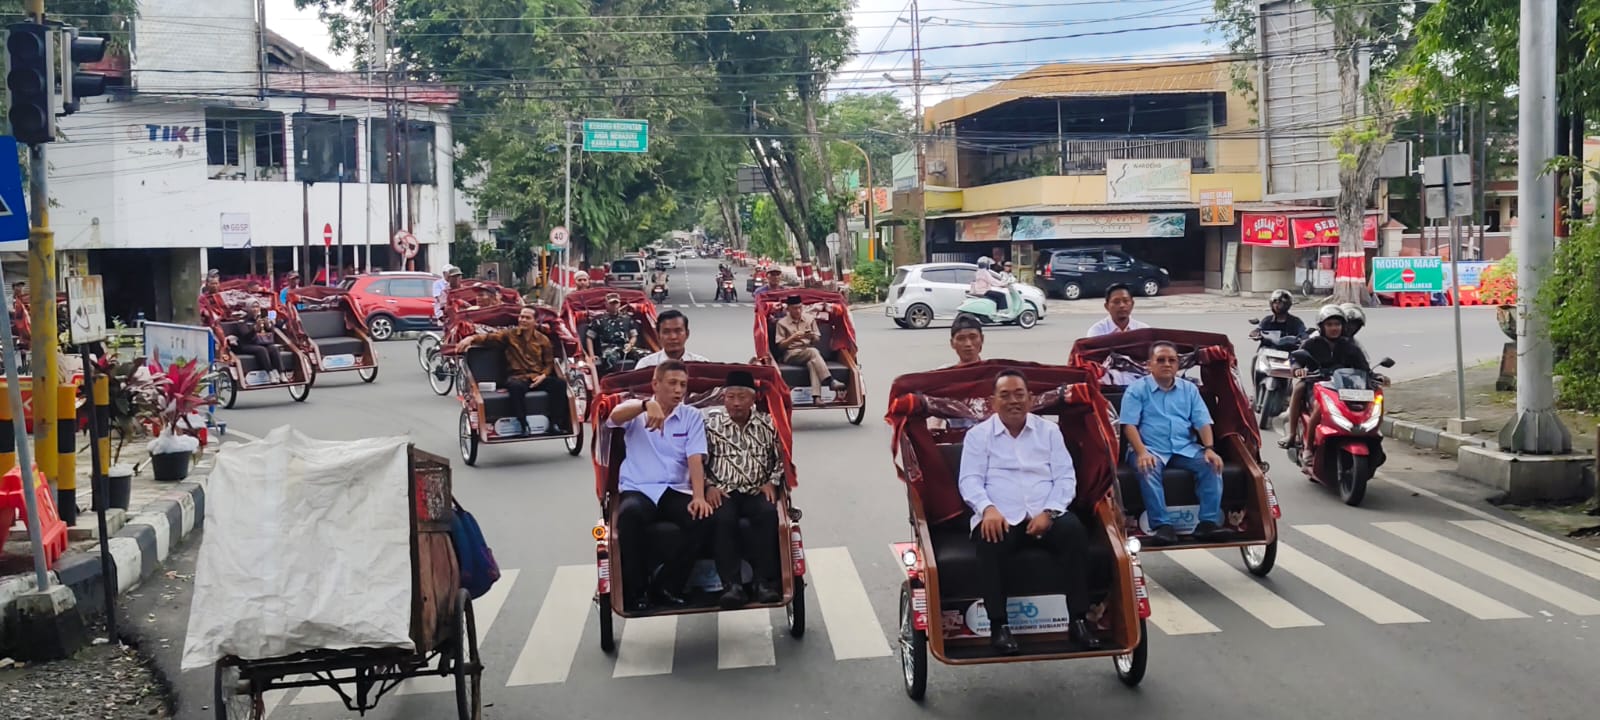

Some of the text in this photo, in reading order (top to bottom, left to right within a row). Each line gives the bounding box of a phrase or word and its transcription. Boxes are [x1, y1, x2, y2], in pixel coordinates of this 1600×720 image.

[145, 124, 200, 142] TIKI
[1314, 218, 1339, 232] SEB
[554, 232, 563, 240] 40
[1376, 259, 1440, 269] MOHON MAAF
